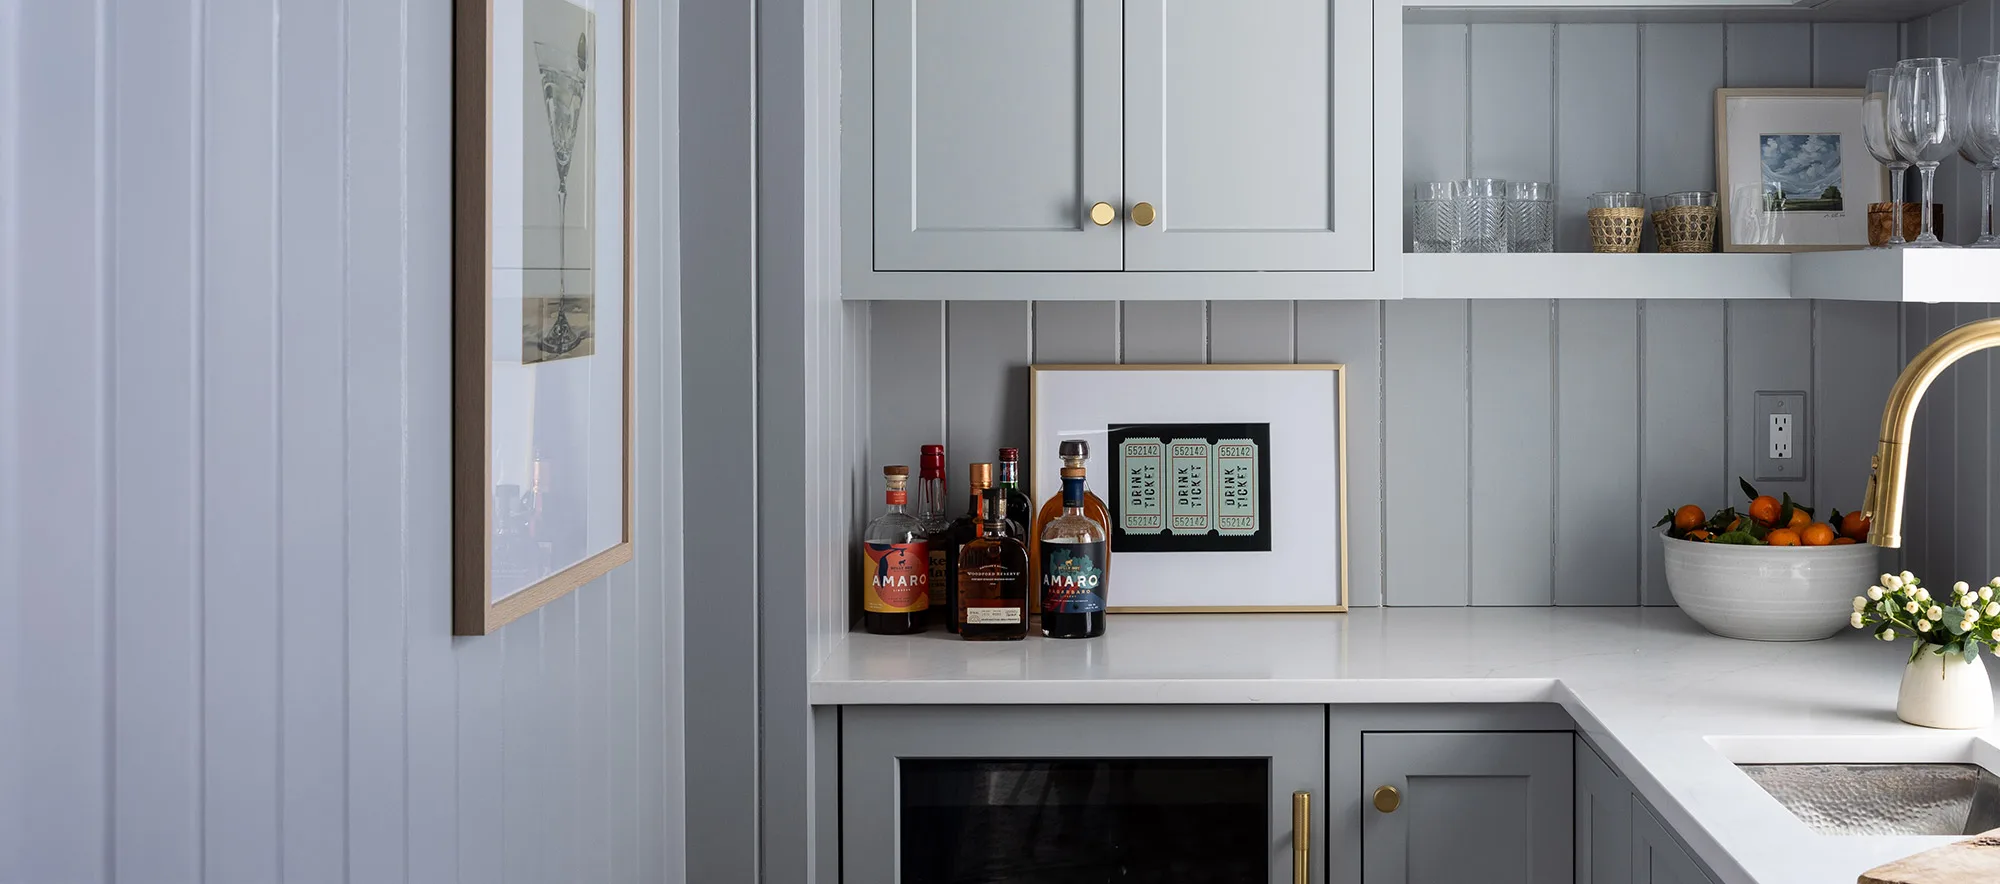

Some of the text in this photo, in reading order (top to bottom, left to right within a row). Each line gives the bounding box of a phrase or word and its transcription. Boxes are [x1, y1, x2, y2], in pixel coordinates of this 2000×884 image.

[1127, 446, 1158, 456] 552142
[1174, 446, 1205, 456] 552142
[1220, 447, 1251, 457] 552142
[1131, 467, 1142, 506] DRINK
[1144, 465, 1155, 508] TICKET
[1178, 467, 1189, 506] DRINK
[1191, 465, 1202, 508] TICKET
[1224, 468, 1235, 506] DRINK
[1237, 465, 1248, 508] TICKET
[1127, 516, 1158, 527] 552142
[1174, 516, 1205, 527] 552142
[1221, 516, 1252, 527] 552142
[872, 573, 927, 587] AMARO
[1043, 574, 1098, 587] AMARO
